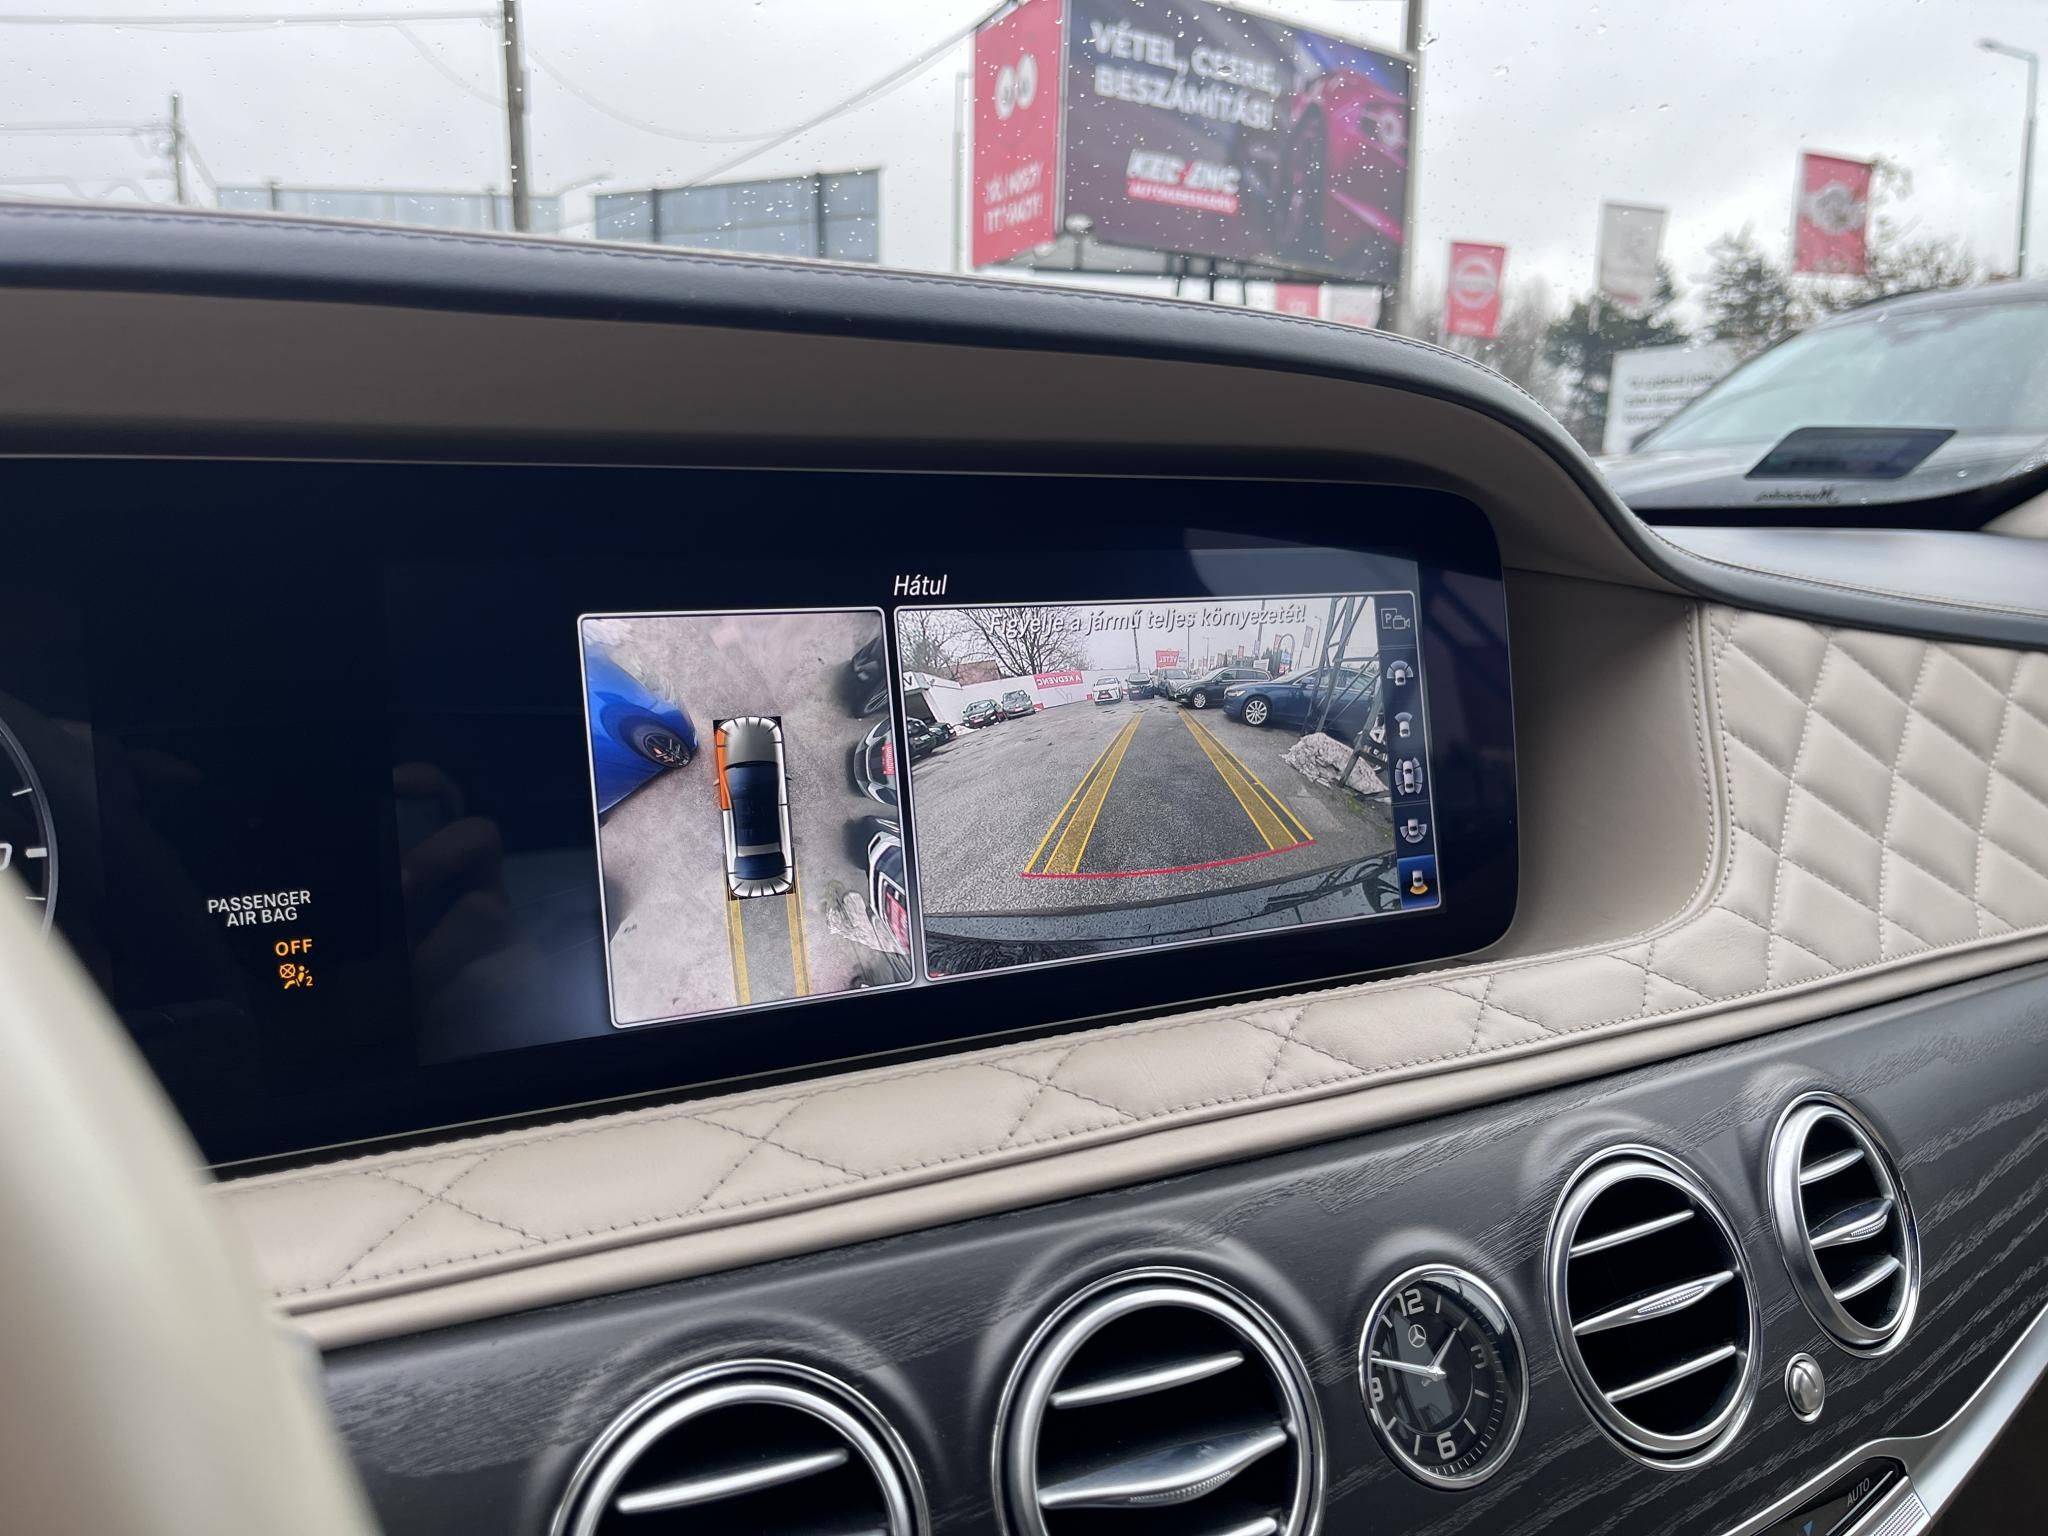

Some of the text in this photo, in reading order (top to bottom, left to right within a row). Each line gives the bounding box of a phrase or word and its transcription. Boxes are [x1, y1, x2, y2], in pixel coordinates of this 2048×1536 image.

[893, 574, 948, 596] Hátul
[989, 604, 1307, 639] Figyelje a jármű teljes környezetét!
[207, 890, 312, 914] PASSENGER
[227, 906, 298, 927] AIR BAG
[275, 938, 313, 956] OFF
[1396, 1288, 1425, 1317] 12
[1470, 1344, 1488, 1369] 3
[1436, 1431, 1457, 1460] 6
[1845, 1477, 1871, 1507] AUTO
